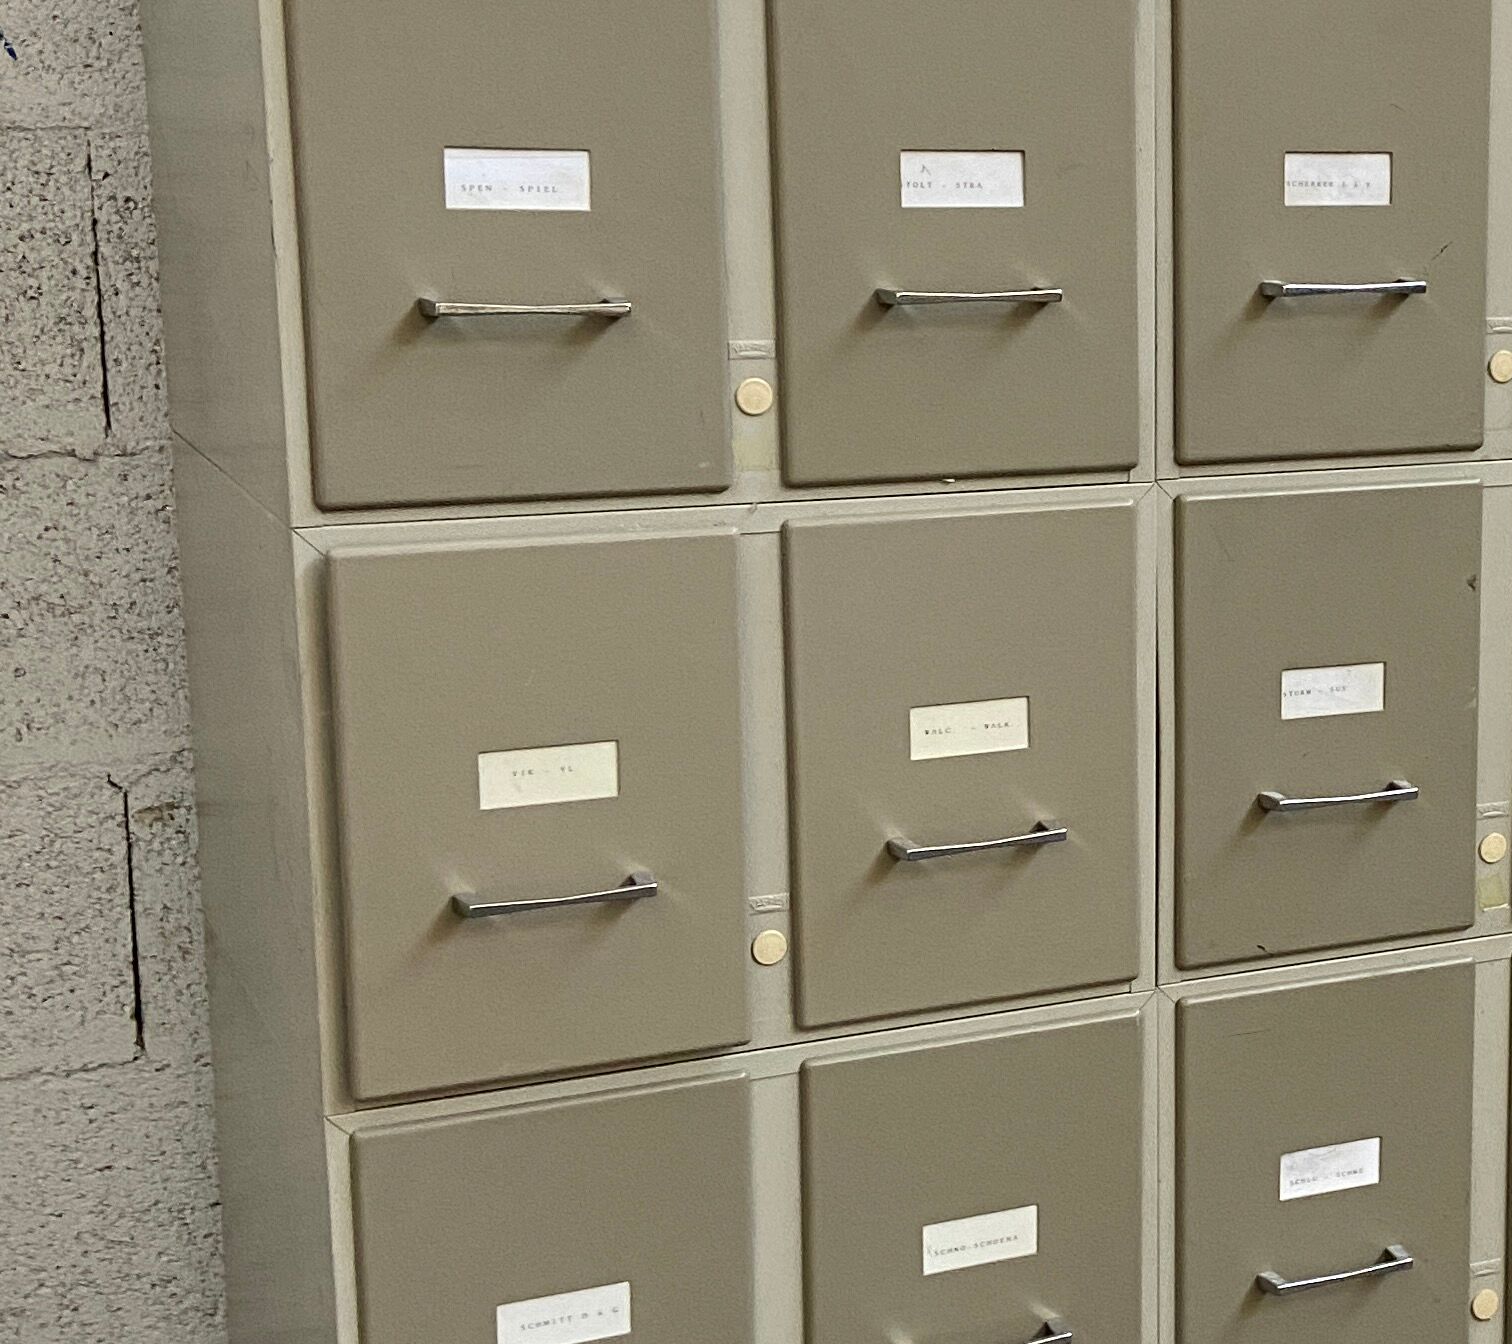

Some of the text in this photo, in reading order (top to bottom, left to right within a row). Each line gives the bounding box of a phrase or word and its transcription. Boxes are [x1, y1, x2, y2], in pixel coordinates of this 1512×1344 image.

[460, 184, 492, 192] SPEN
[518, 185, 558, 193] SPIEL
[924, 727, 952, 736] WALC
[520, 1316, 572, 1332] SCHMITT
